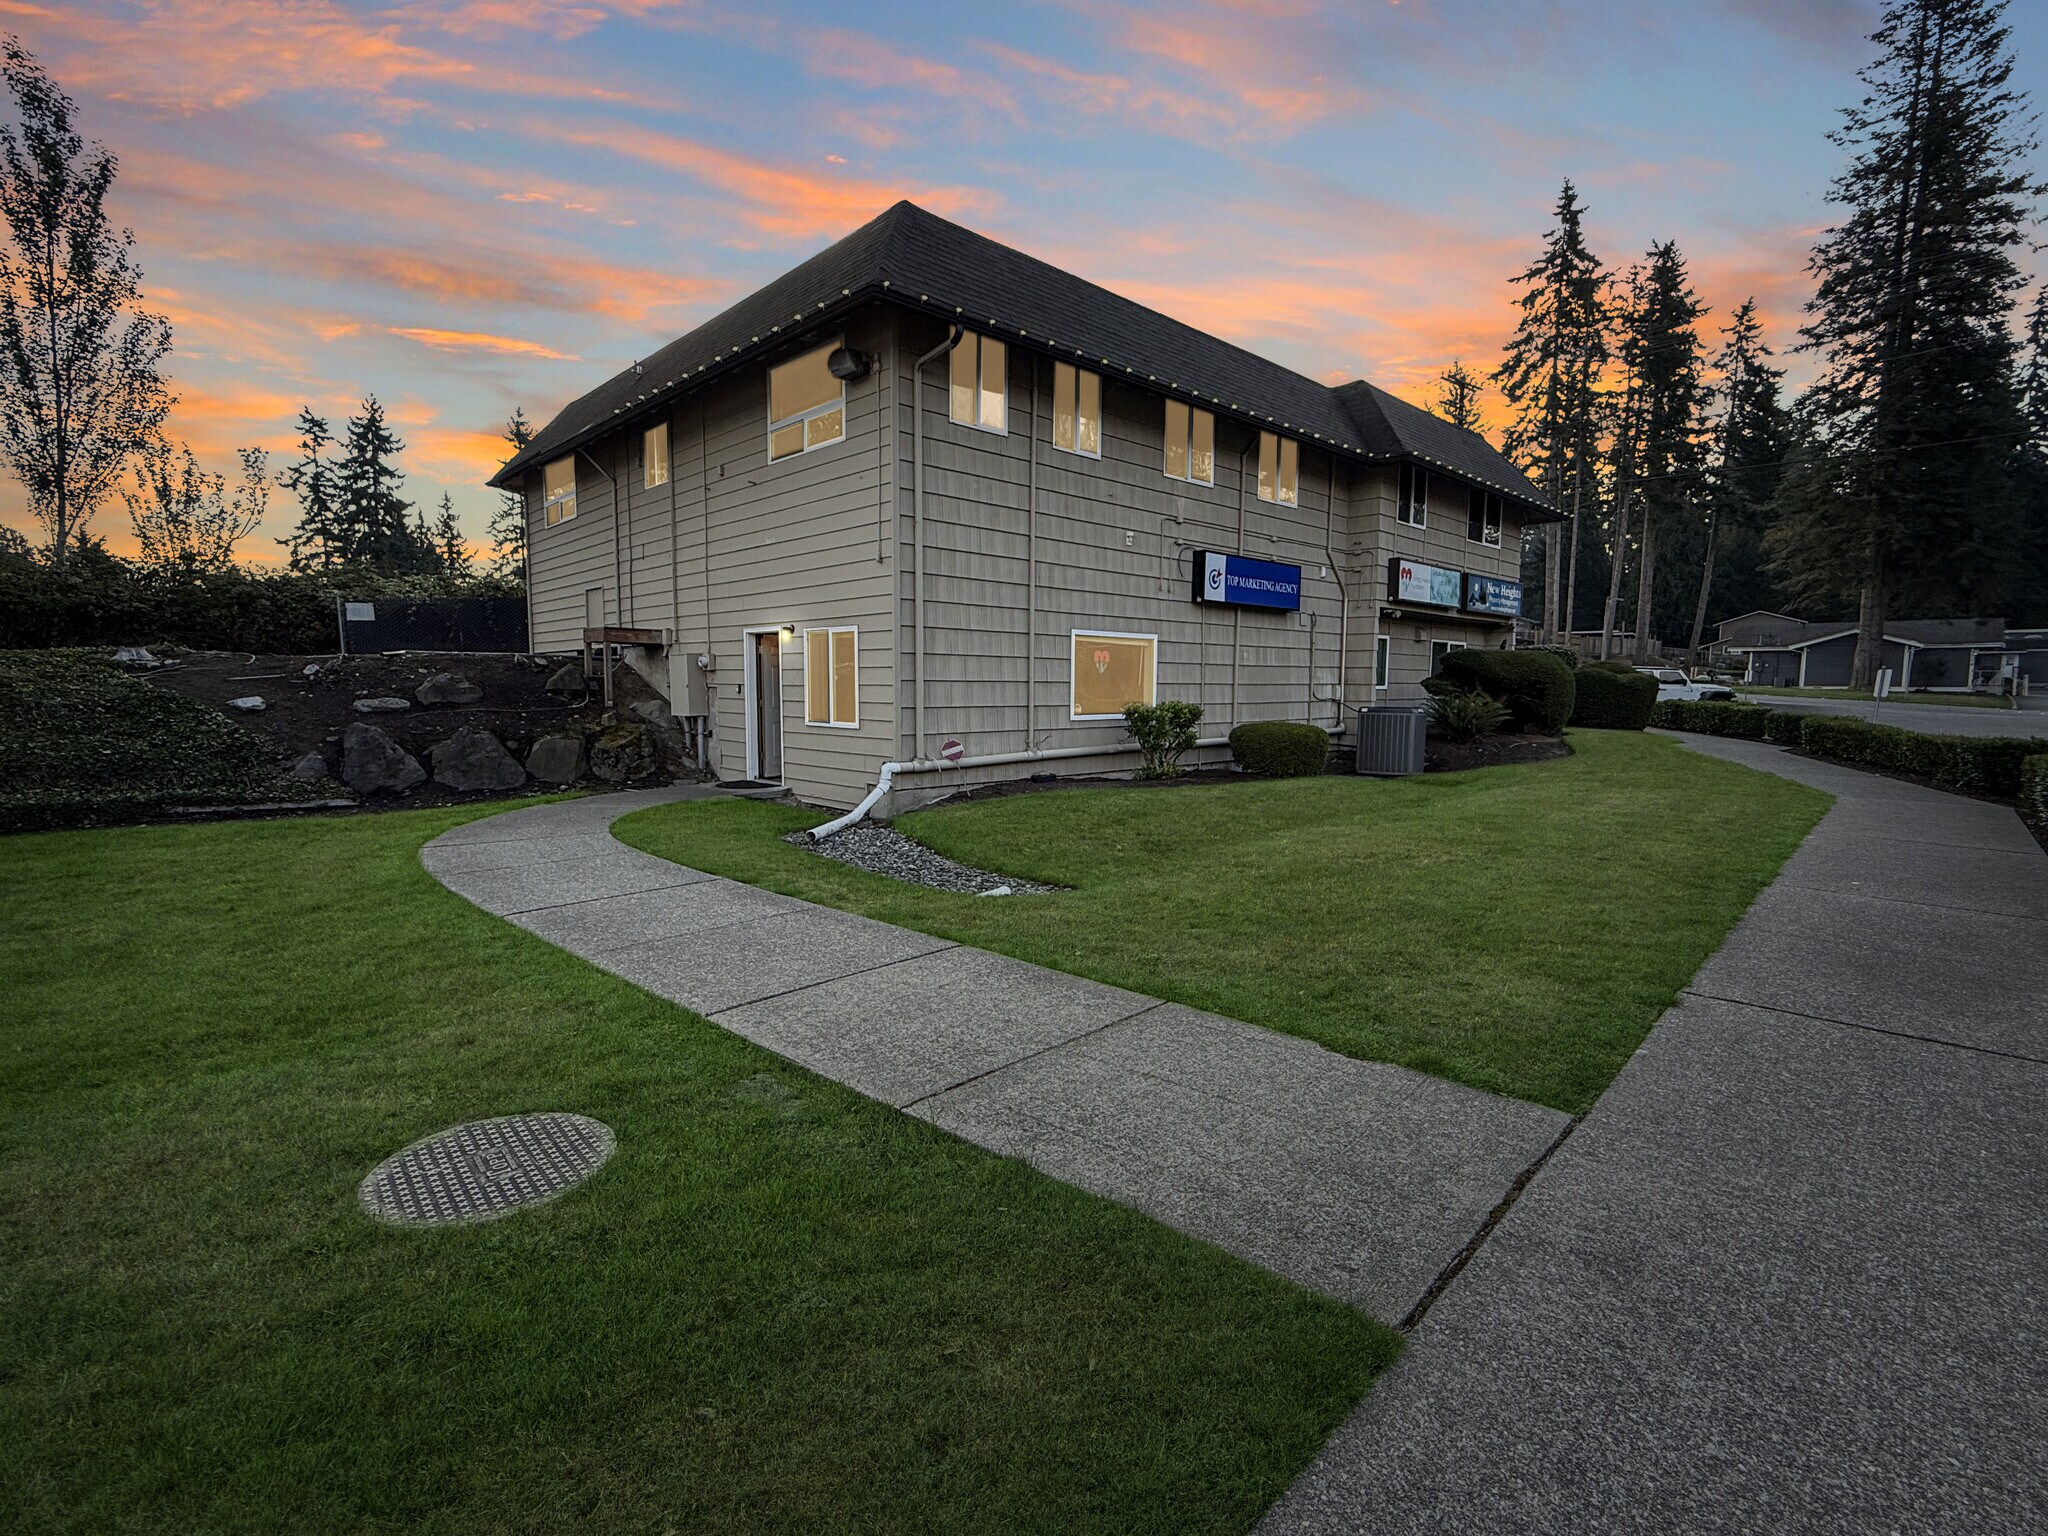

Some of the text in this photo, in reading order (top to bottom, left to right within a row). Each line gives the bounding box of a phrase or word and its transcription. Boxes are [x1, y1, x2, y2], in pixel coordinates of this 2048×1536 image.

[1227, 575, 1298, 594] TOP MARKETING AGENCY
[1487, 582, 1521, 600] New Heights
